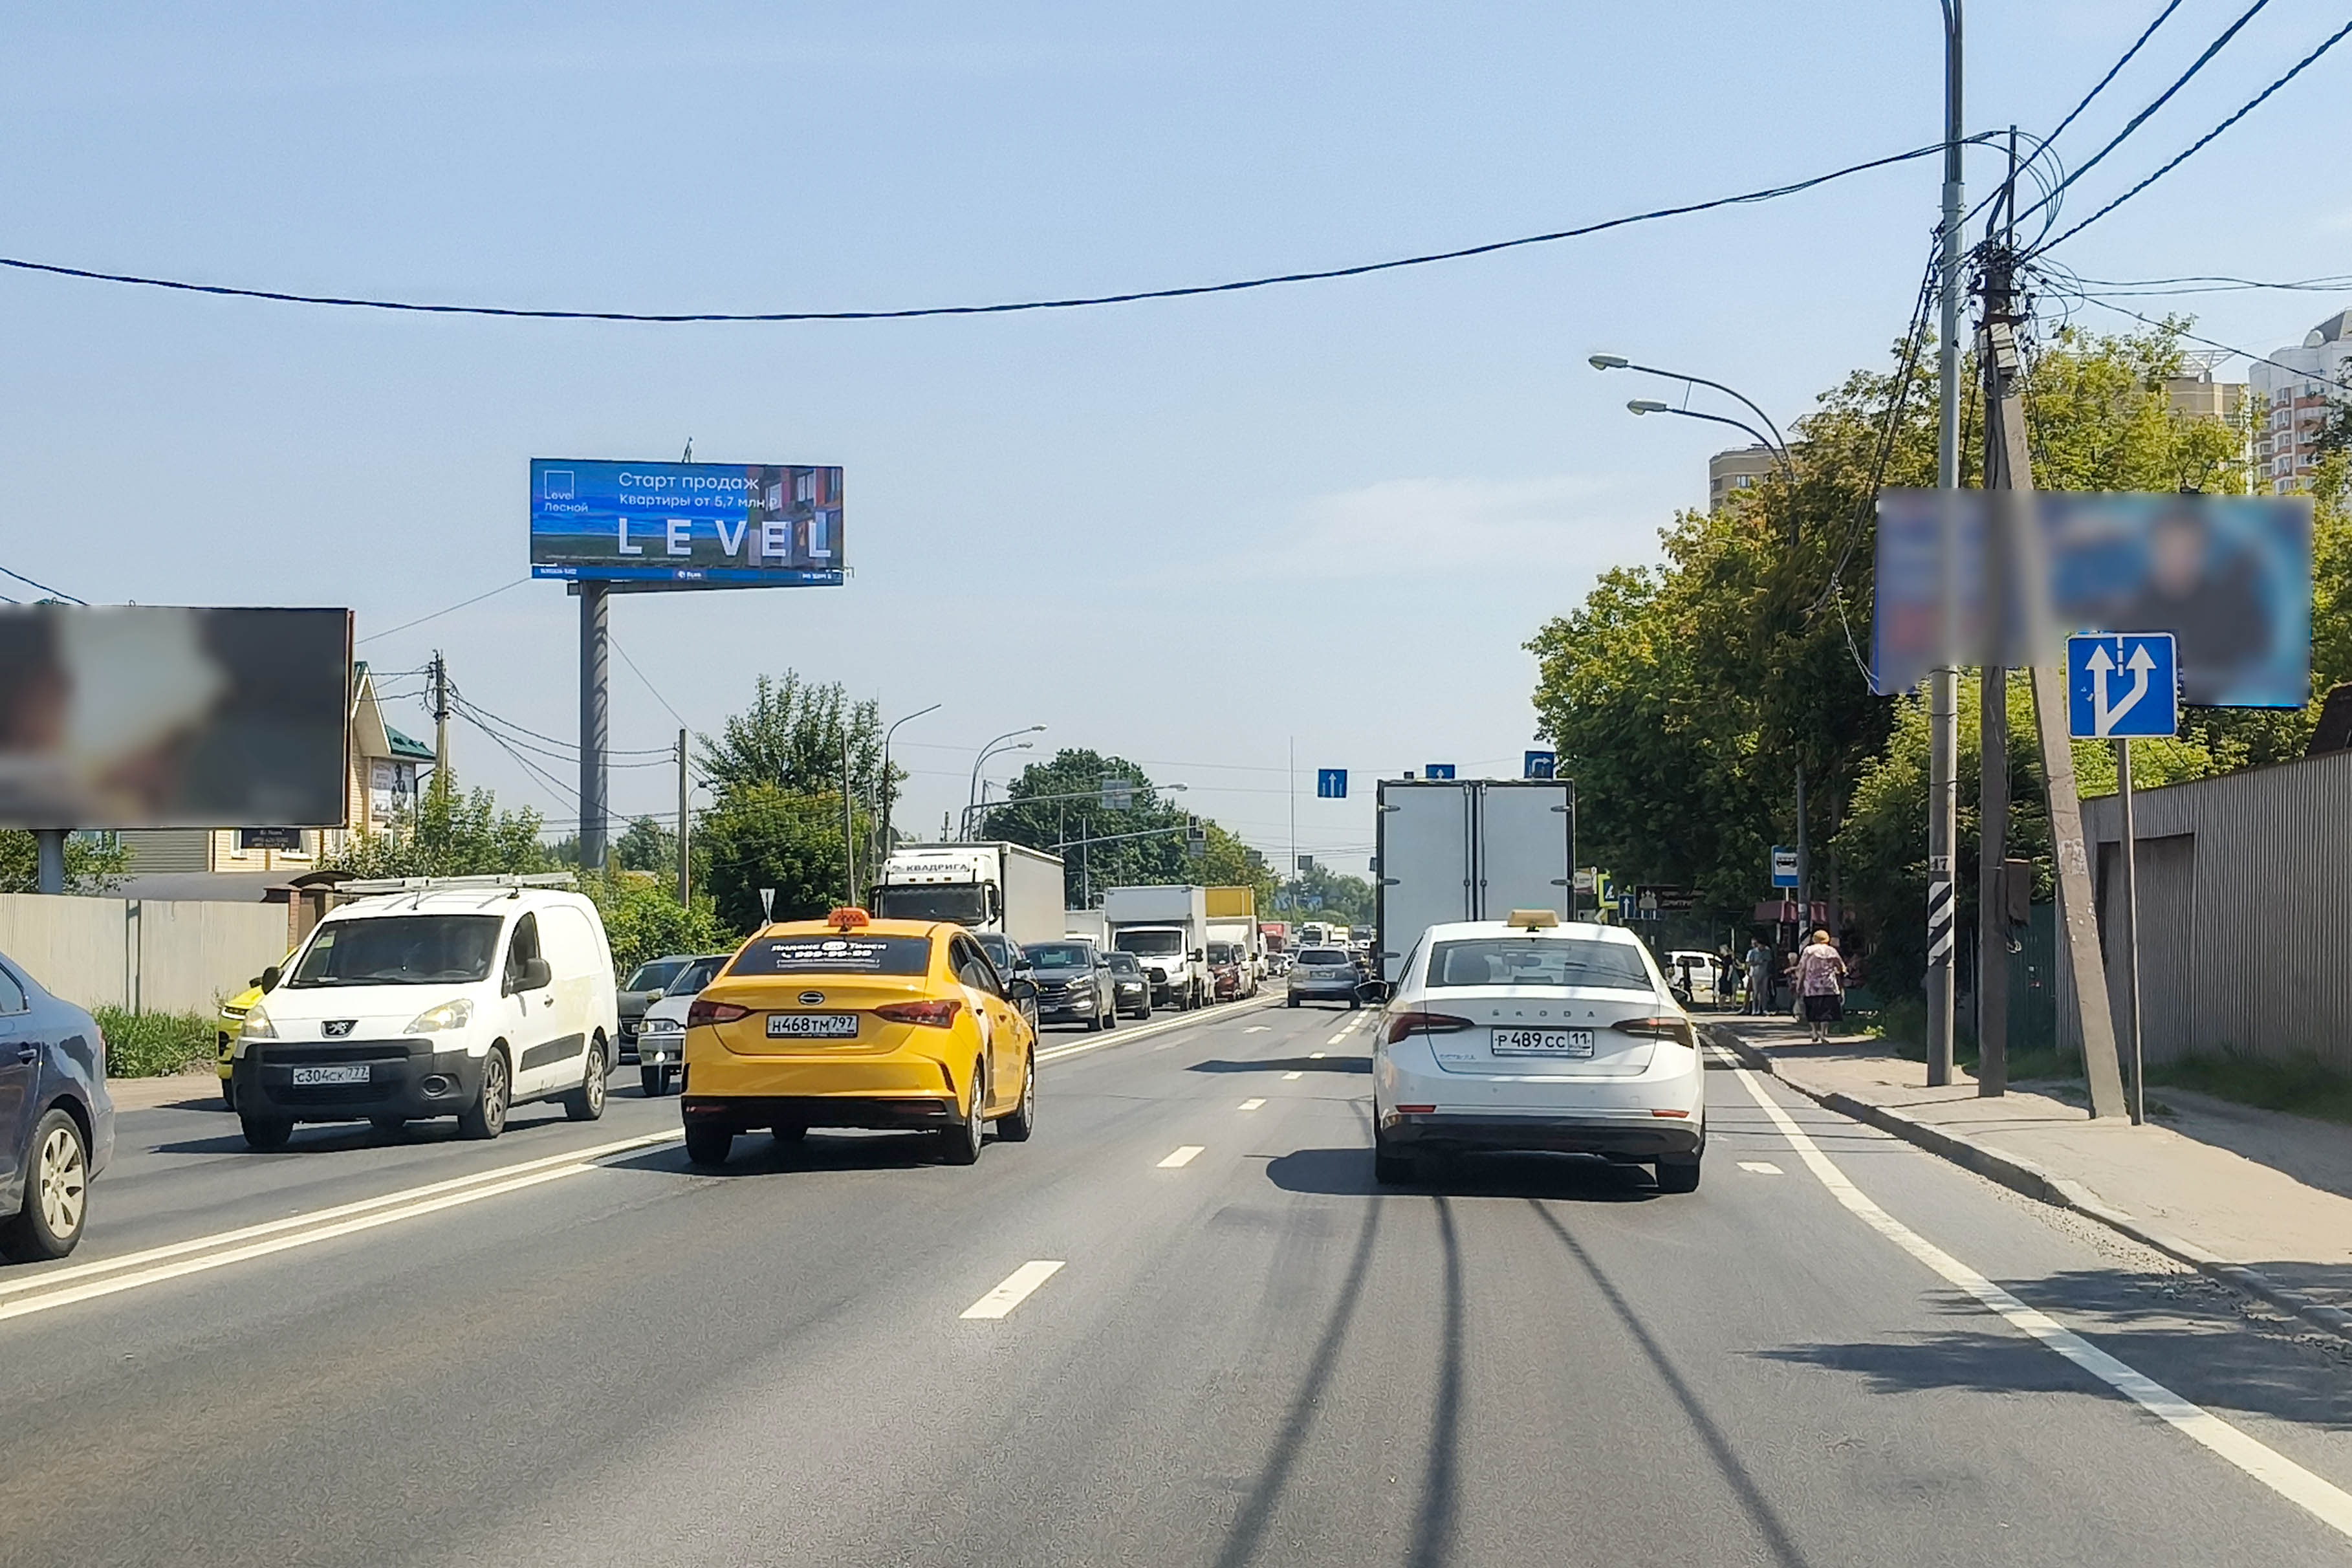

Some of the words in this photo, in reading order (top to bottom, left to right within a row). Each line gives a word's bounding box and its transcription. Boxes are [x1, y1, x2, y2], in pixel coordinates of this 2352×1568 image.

[619, 472, 676, 492] Старт
[682, 477, 759, 492] продаж
[545, 502, 588, 512] Лесной
[620, 494, 690, 508] Квартиры
[695, 497, 711, 507] от
[715, 496, 734, 509] 5,7
[738, 498, 765, 508] млн
[619, 517, 831, 558] LEVEL
[906, 864, 968, 872] КВАДРИГА
